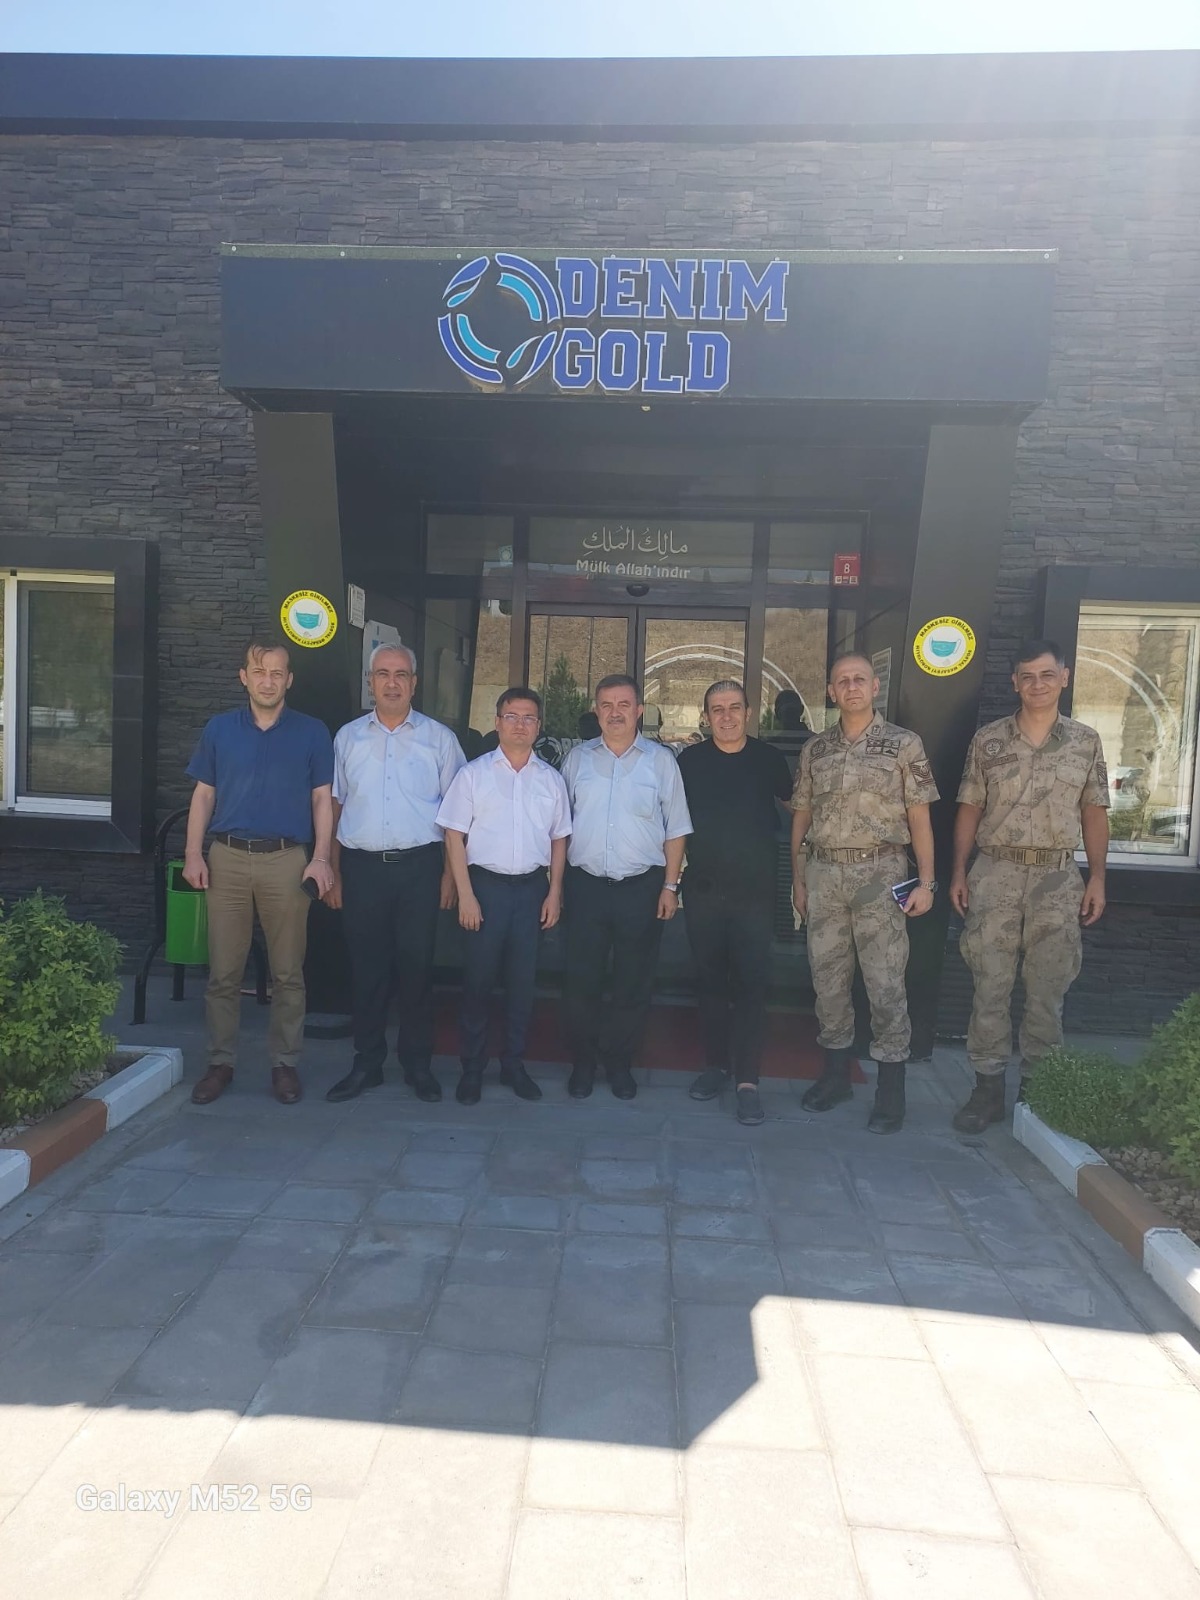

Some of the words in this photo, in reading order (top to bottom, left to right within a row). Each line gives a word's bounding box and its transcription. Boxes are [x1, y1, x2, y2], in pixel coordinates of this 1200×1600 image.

[555, 256, 790, 322] DENIM
[552, 327, 731, 394] GOLD
[576, 559, 611, 574] Mülk
[843, 563, 851, 574] 8
